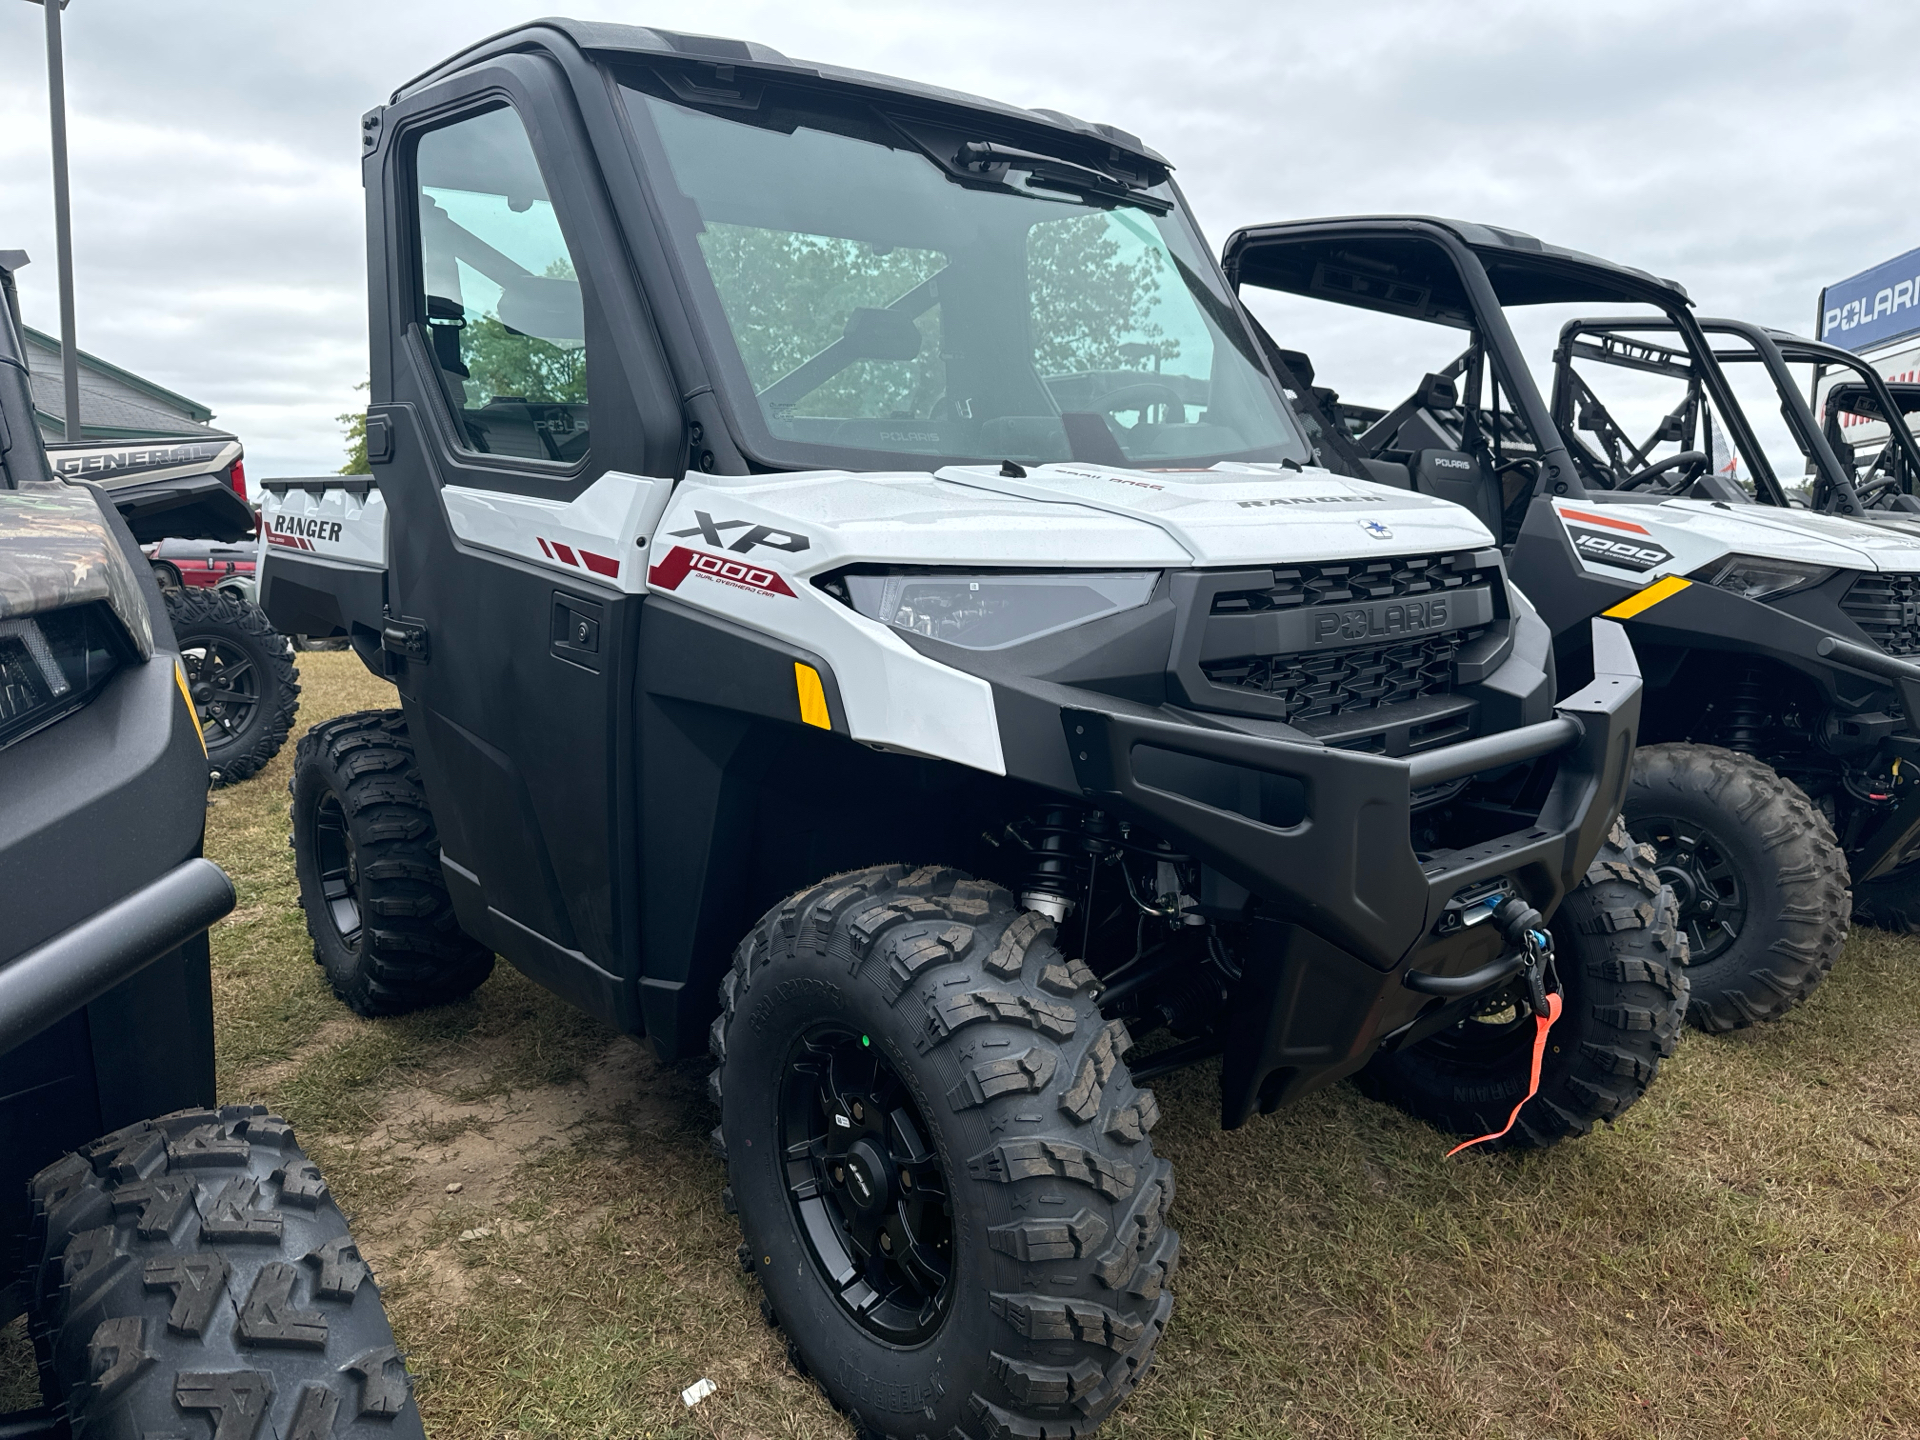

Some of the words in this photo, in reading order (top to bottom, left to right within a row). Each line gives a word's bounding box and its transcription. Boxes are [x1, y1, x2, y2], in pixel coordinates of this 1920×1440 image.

[533, 419, 590, 432] POLA
[880, 432, 940, 441] POLARIS
[56, 446, 212, 475] GENERAL
[1435, 458, 1471, 470] POLARIS
[1236, 496, 1387, 509] RANGER
[274, 514, 343, 543] RANGER
[666, 510, 811, 554] XP
[1575, 534, 1667, 561] 1000
[689, 553, 774, 587] 1000
[695, 572, 714, 582] DUAL
[716, 578, 756, 593] OVERHEAD
[757, 589, 775, 598] CAM
[1314, 598, 1448, 644] POLARIS
